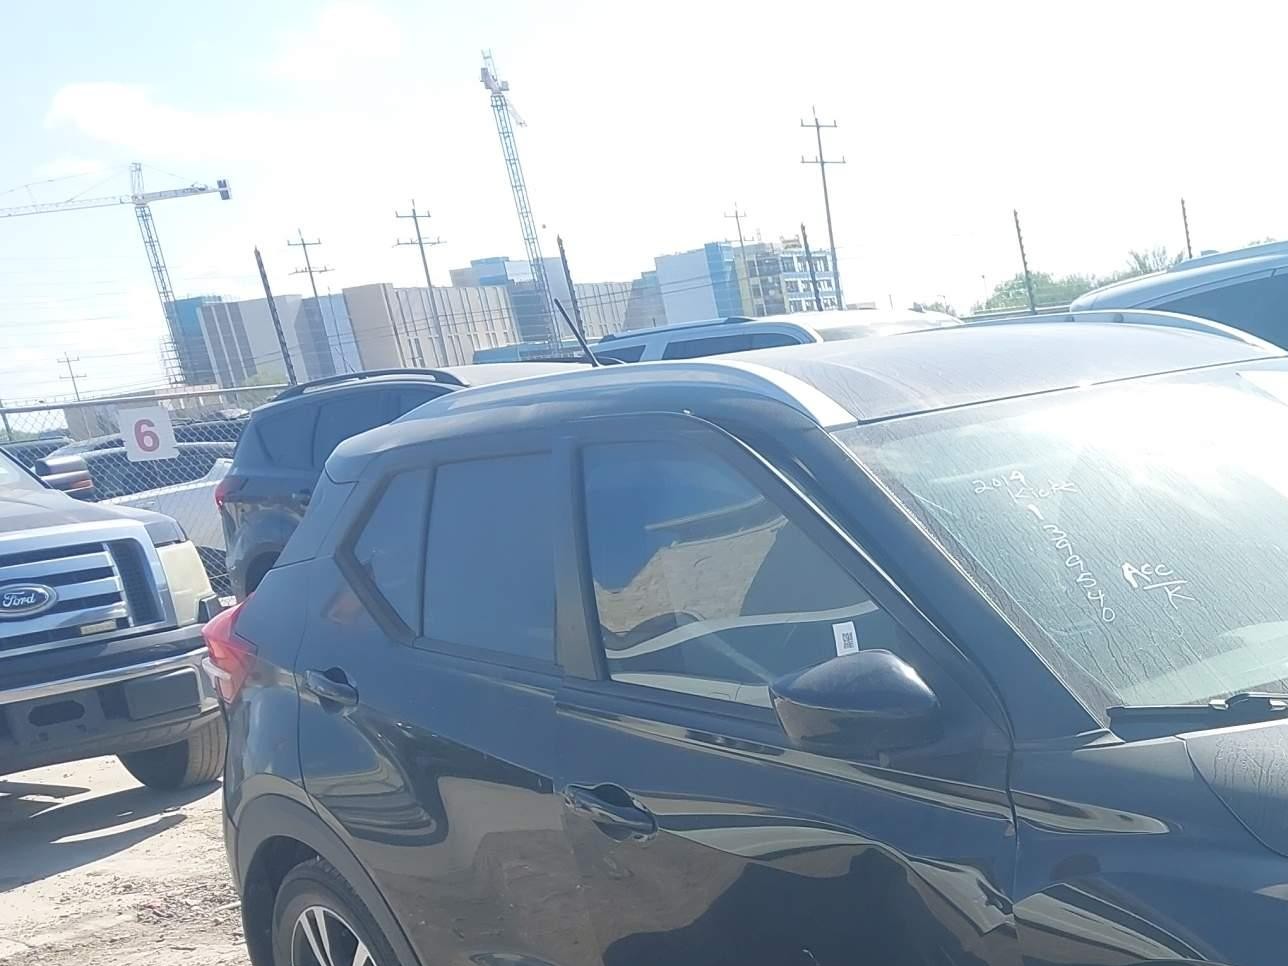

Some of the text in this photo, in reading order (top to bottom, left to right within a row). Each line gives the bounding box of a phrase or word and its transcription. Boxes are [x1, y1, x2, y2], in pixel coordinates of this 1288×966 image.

[134, 419, 160, 452] 6
[972, 470, 1028, 494] 2019
[2, 591, 36, 608] Ford
